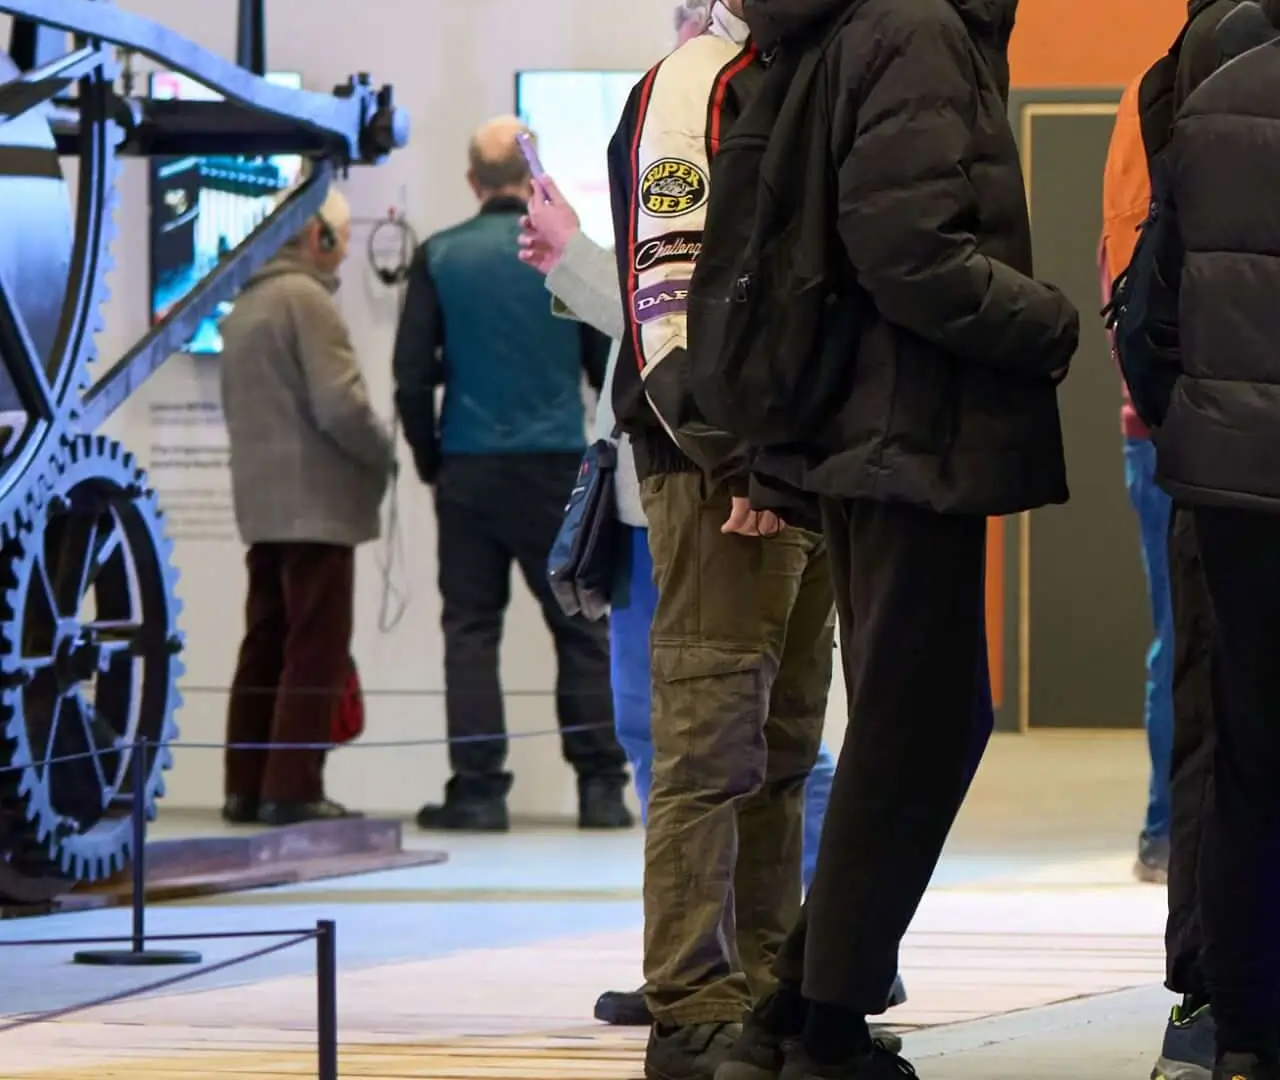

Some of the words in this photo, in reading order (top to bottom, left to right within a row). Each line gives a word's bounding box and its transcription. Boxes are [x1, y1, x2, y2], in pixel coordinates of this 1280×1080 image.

[643, 162, 700, 193] SUPER
[647, 194, 694, 212] BEE
[636, 236, 702, 269] Challeng
